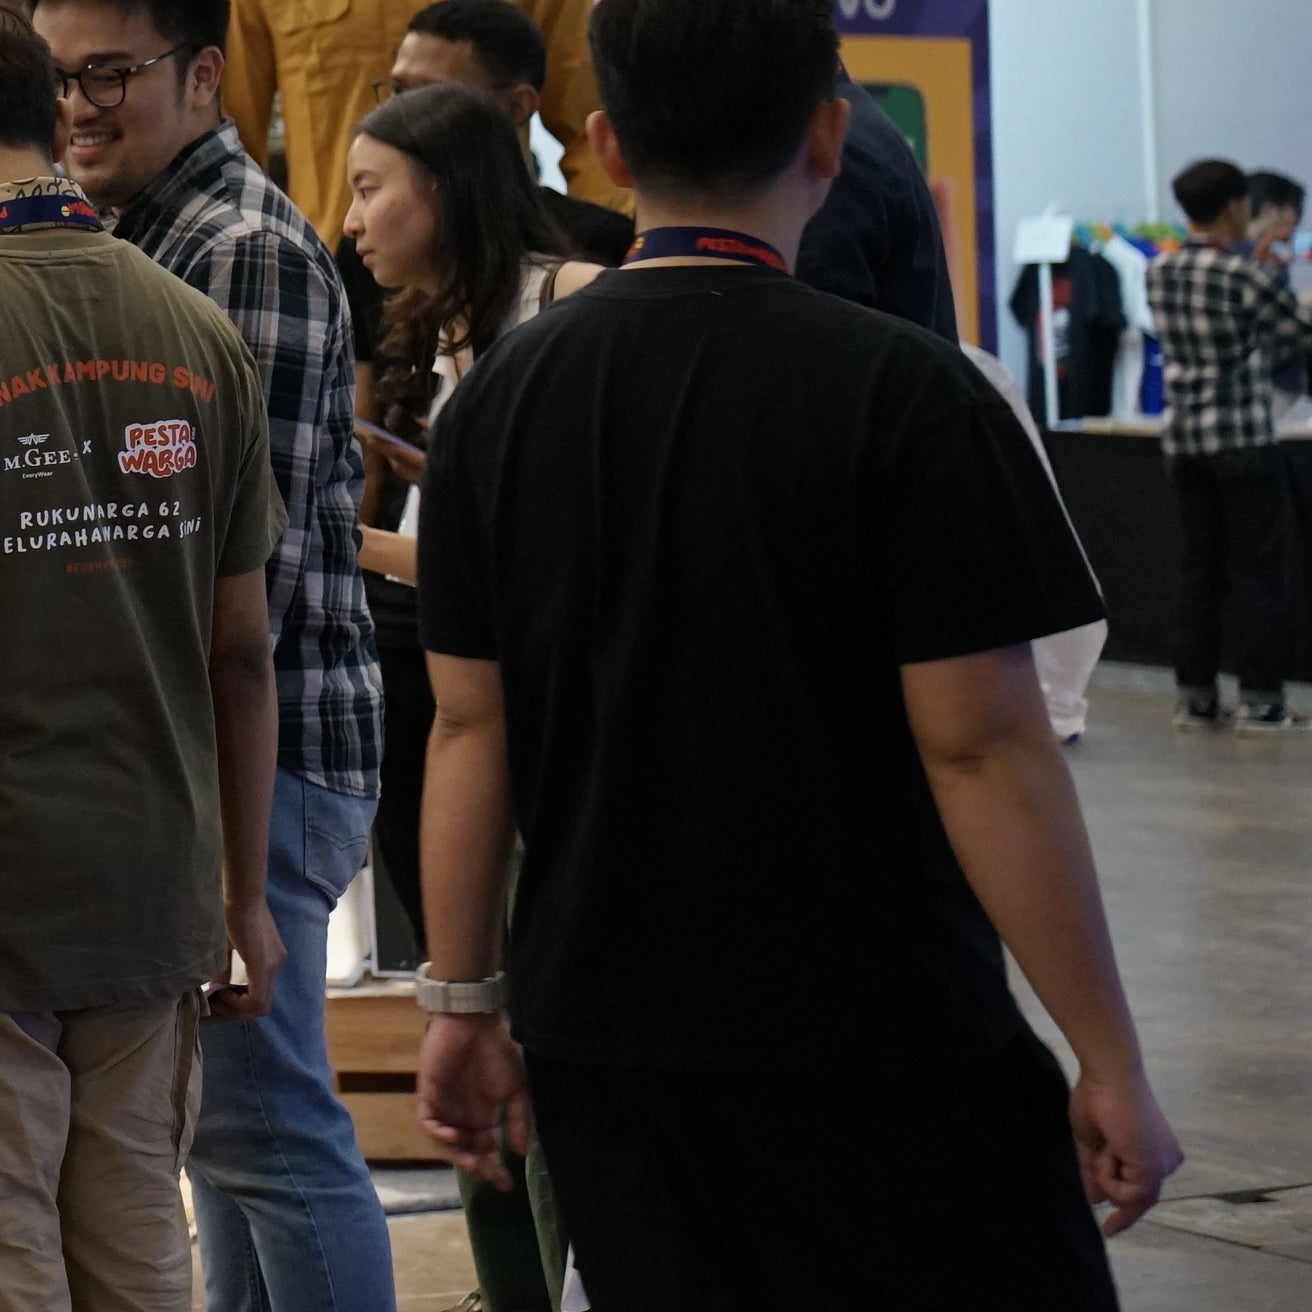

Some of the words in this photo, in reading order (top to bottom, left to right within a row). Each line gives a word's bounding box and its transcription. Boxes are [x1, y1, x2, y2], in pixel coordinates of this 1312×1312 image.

[46, 359, 166, 385] KAMPUNG
[128, 423, 190, 449] PESTA
[4, 448, 72, 471] M.GEE
[120, 446, 196, 476] WARGA
[158, 501, 181, 517] 62
